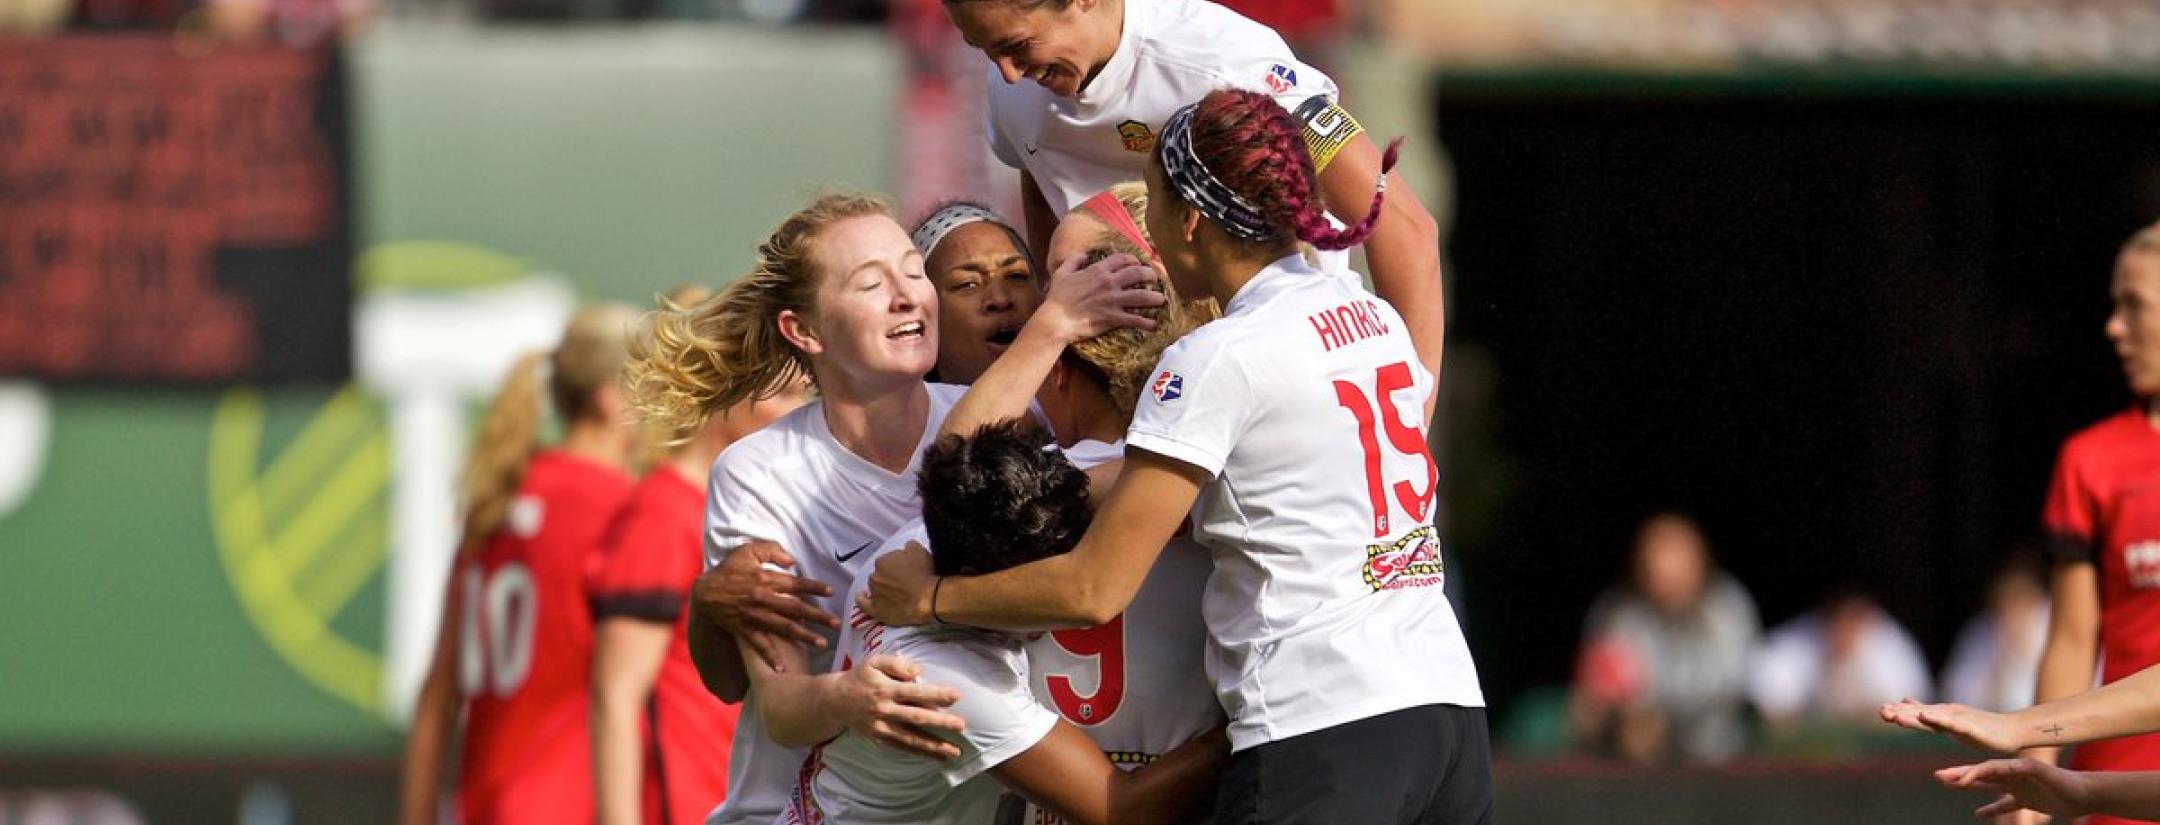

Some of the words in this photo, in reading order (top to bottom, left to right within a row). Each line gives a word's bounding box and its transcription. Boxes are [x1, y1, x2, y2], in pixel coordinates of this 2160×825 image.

[1332, 361, 1438, 538] 15
[460, 563, 538, 698] 10
[1046, 610, 1125, 726] 9
